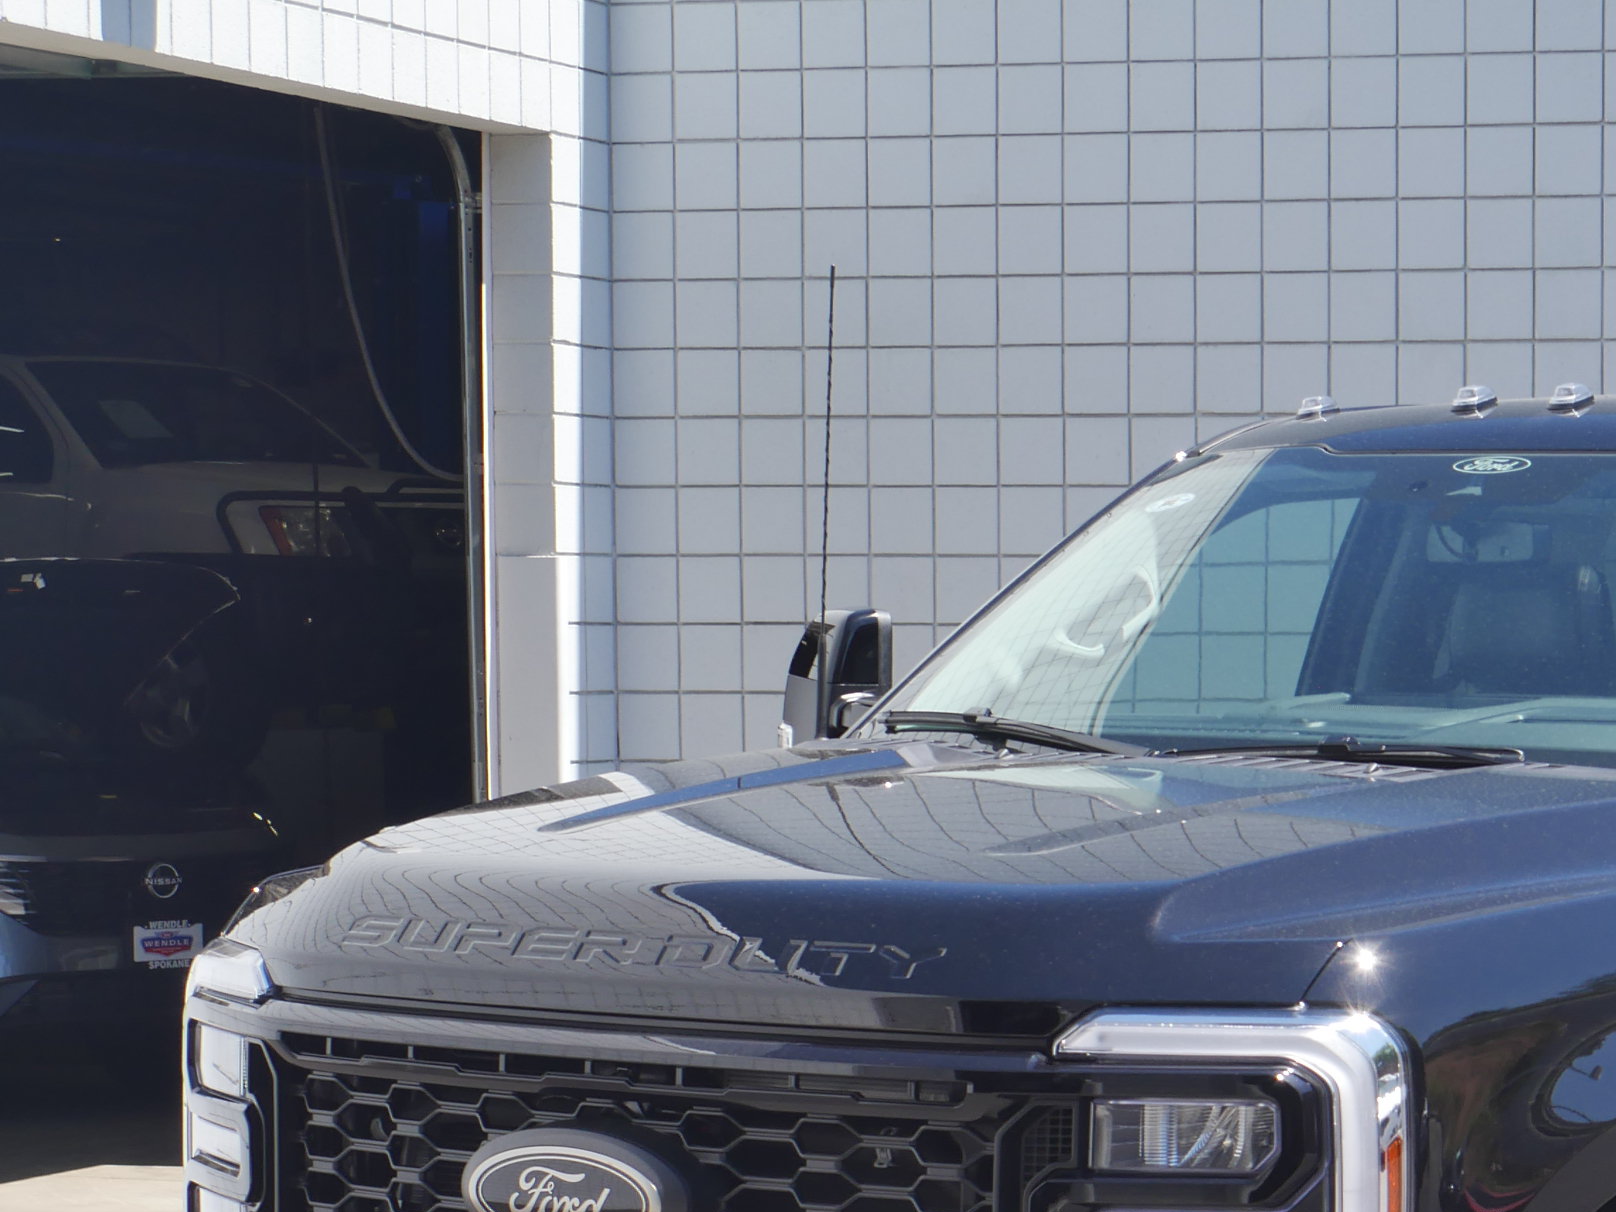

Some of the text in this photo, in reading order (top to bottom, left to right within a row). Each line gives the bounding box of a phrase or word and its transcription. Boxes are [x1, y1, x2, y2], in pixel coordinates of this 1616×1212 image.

[1463, 458, 1519, 471] Ford
[145, 877, 182, 885] NISSAN
[149, 920, 189, 930] WENDLE
[143, 939, 190, 948] WENDLE
[342, 915, 947, 980] SUPER DUTY
[148, 960, 190, 970] SPOKANE
